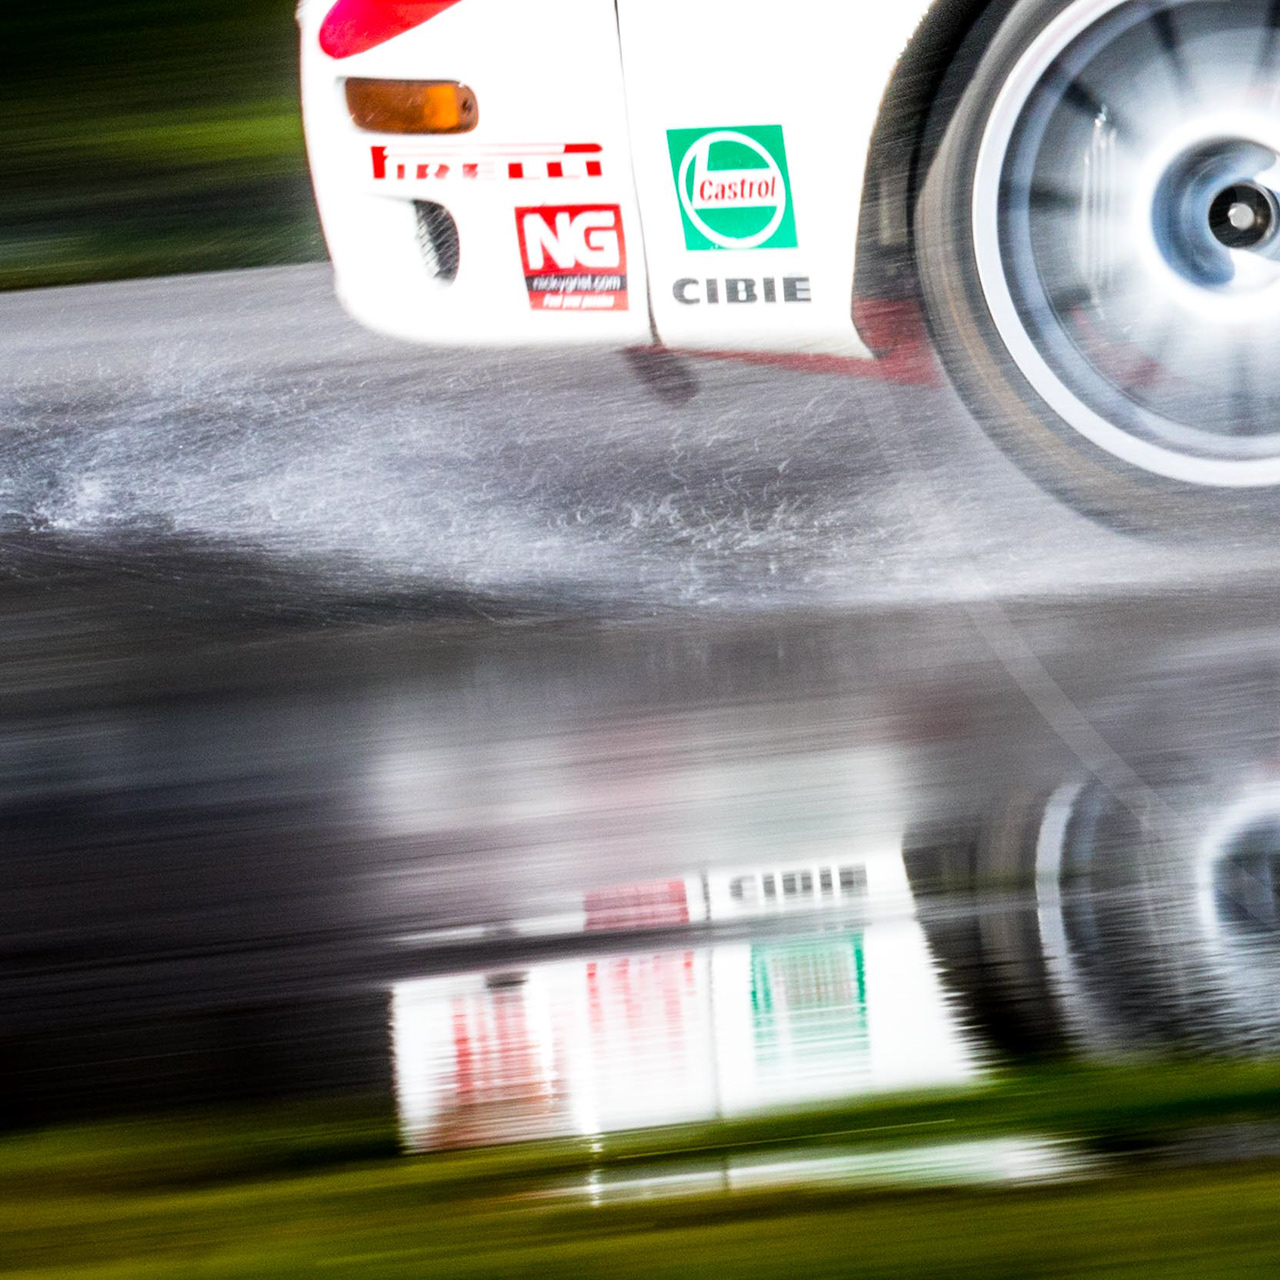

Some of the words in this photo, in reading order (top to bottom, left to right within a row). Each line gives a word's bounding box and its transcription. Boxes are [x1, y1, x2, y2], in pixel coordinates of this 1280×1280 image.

[699, 176, 776, 201] Castrol
[522, 209, 621, 271] NG
[672, 276, 812, 306] CIBIE
